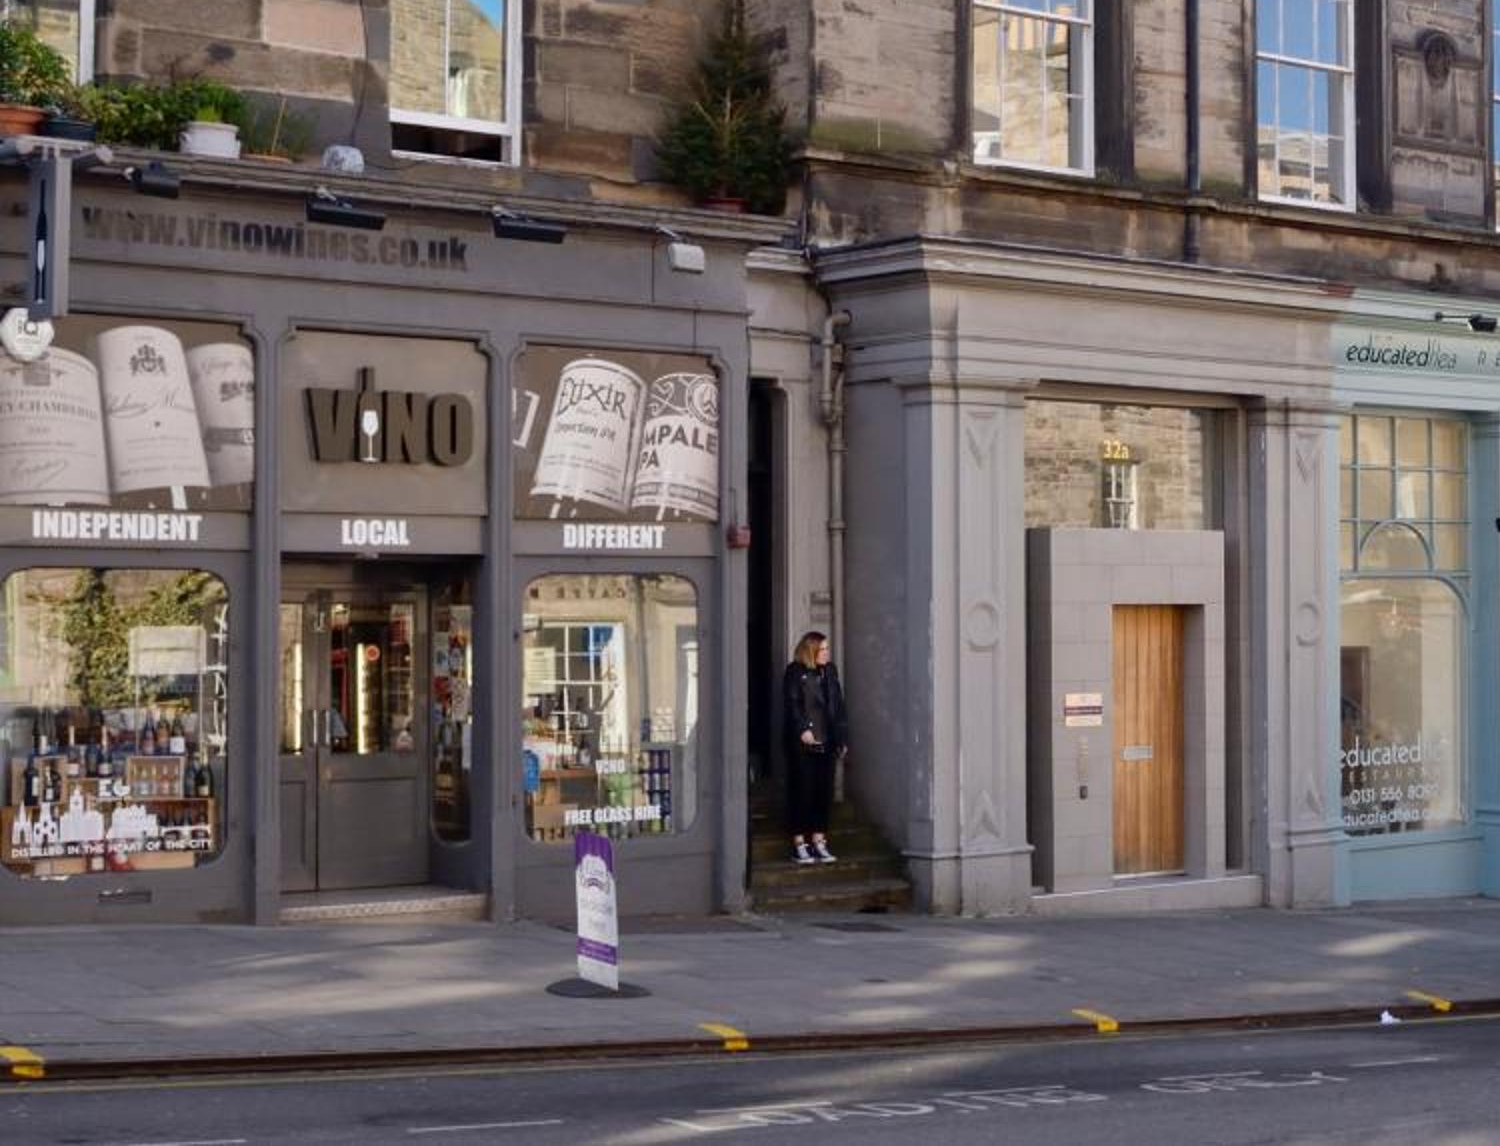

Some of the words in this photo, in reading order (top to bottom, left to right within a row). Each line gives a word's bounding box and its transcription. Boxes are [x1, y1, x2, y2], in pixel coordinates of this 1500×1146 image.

[302, 367, 474, 467] VINO
[1103, 439, 1129, 460] 32a
[32, 510, 203, 541] INDEPENDENT
[341, 518, 410, 546] LOCAL
[563, 524, 665, 549] DIFFERENT
[564, 808, 592, 825] FREE
[658, 1085, 1108, 1133] LOADING
